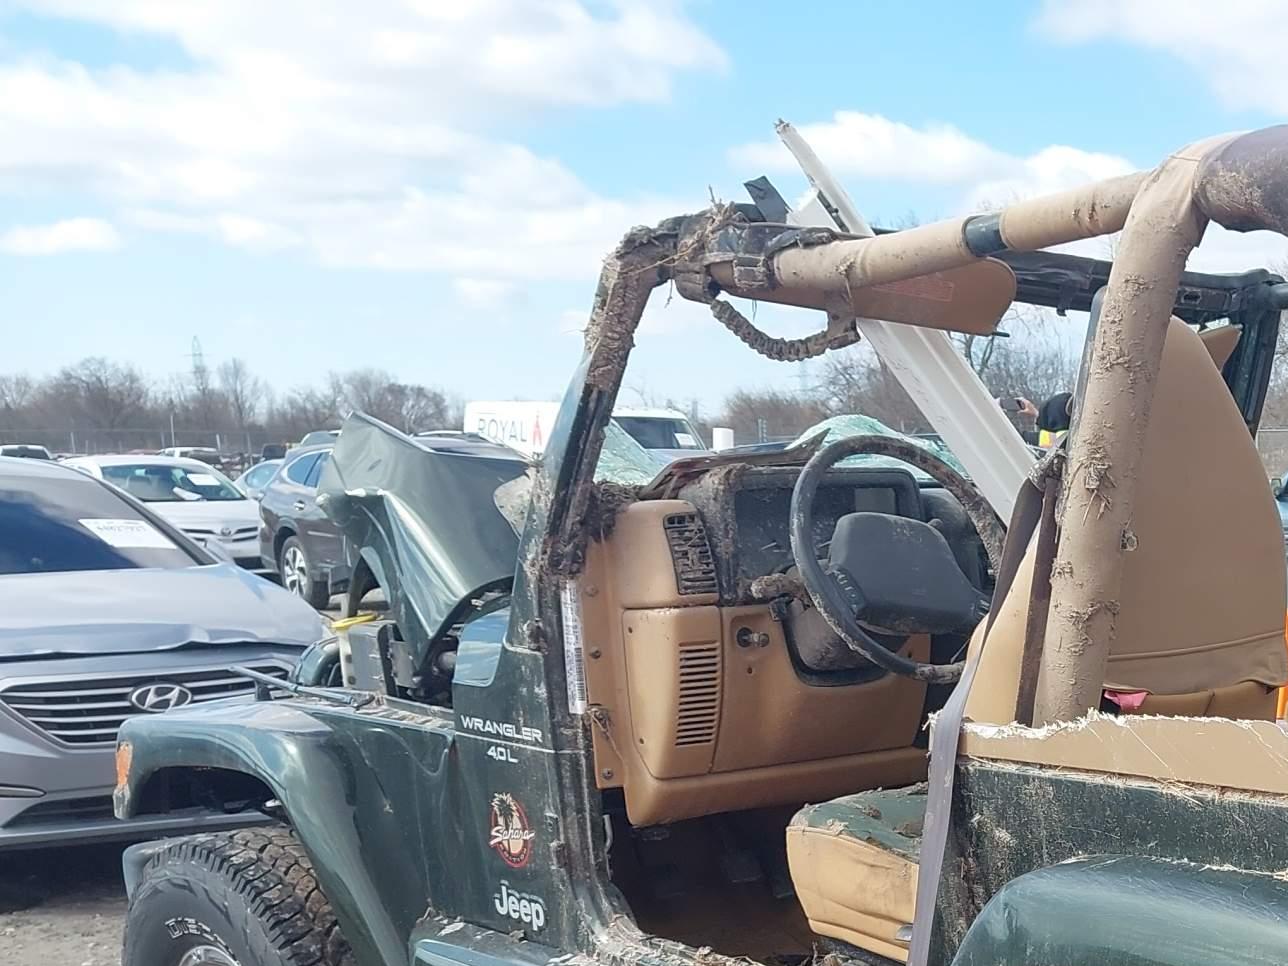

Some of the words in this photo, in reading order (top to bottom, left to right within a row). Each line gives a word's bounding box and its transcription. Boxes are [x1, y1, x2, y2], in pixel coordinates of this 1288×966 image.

[478, 418, 527, 442] ROYAL
[460, 714, 543, 743] WRANGLER
[489, 825, 535, 847] Sahara
[494, 883, 546, 931] Jeep
